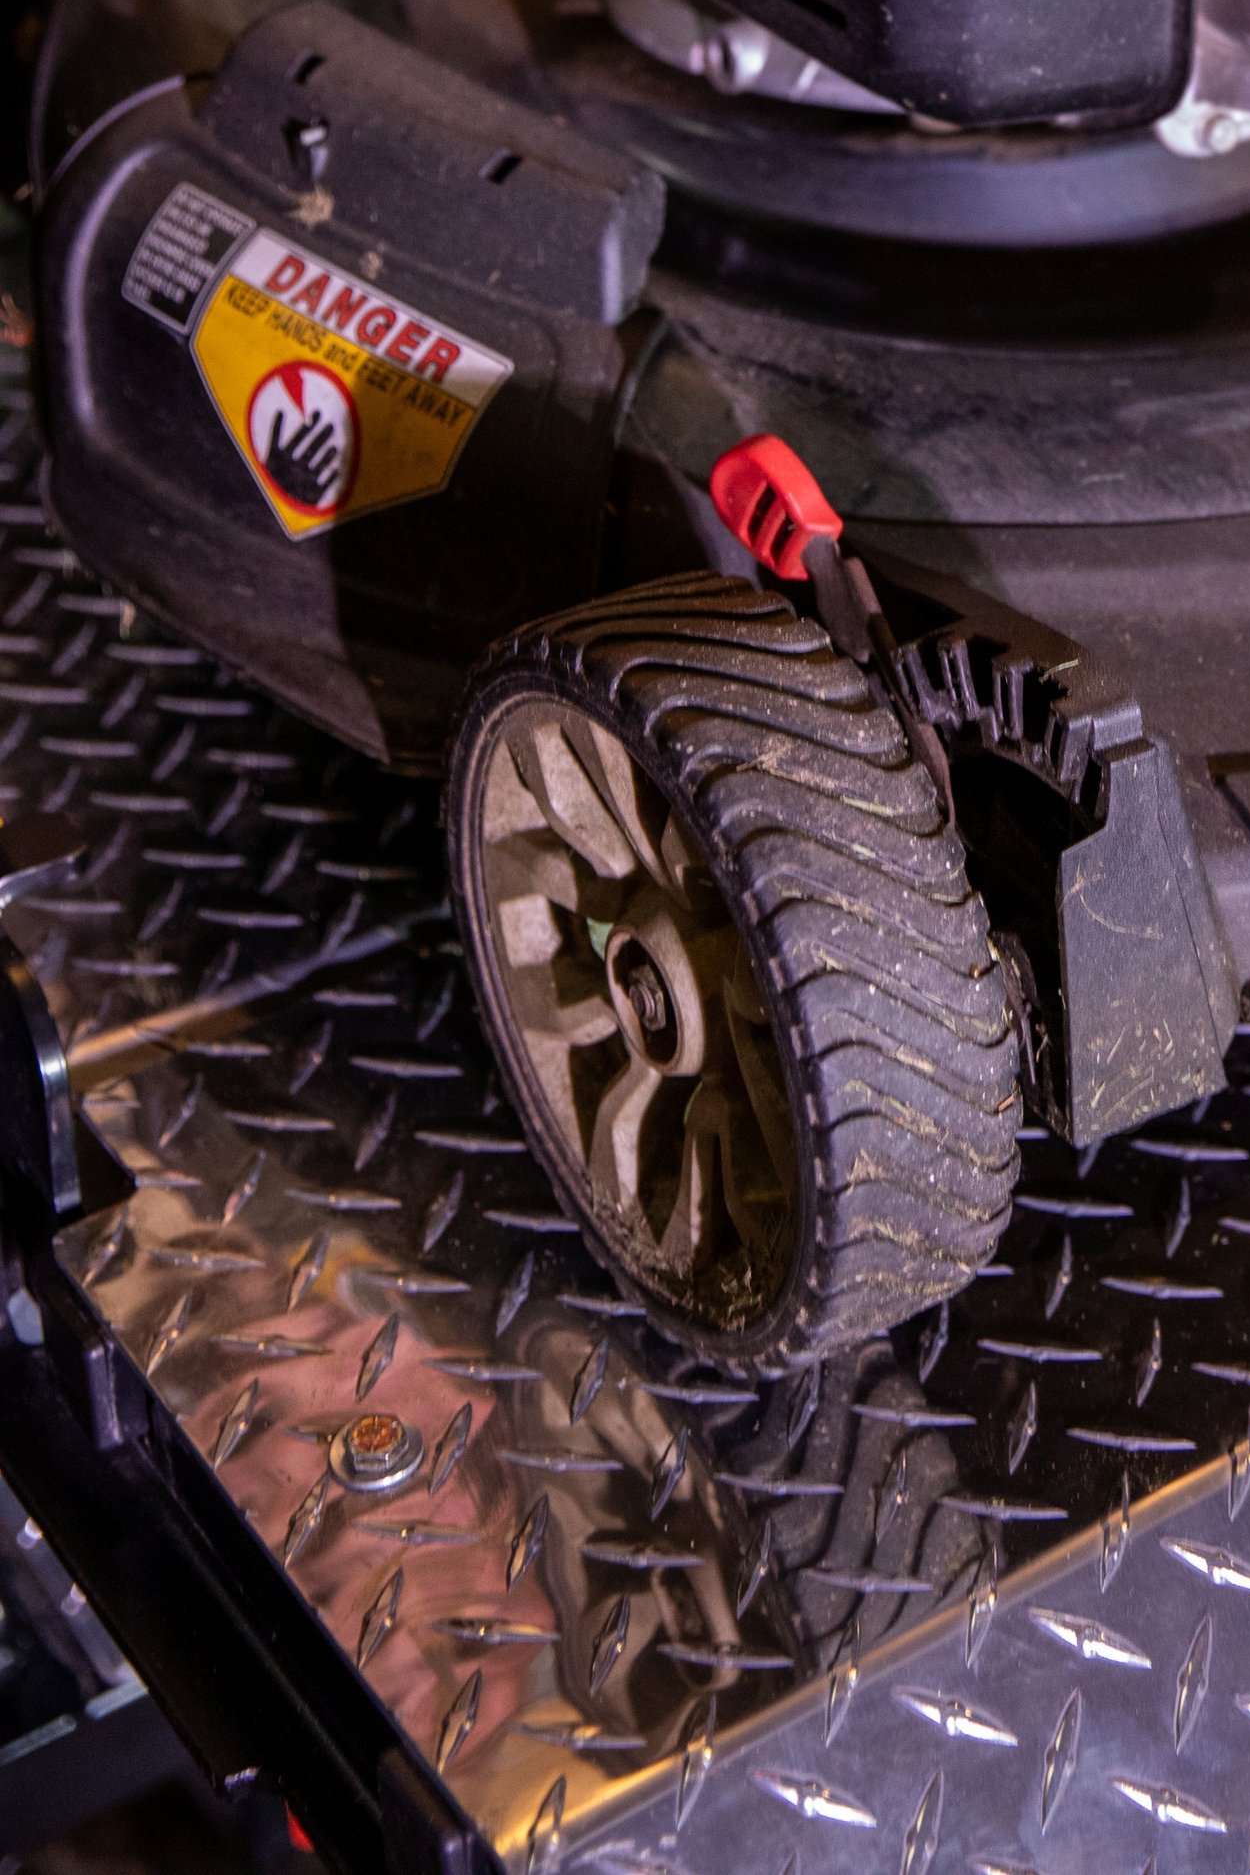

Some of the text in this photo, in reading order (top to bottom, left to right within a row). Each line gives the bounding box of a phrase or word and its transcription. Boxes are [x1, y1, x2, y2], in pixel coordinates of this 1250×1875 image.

[226, 283, 469, 425] KEEP HANDS and FEET AWAY
[263, 254, 461, 384] DANGER
